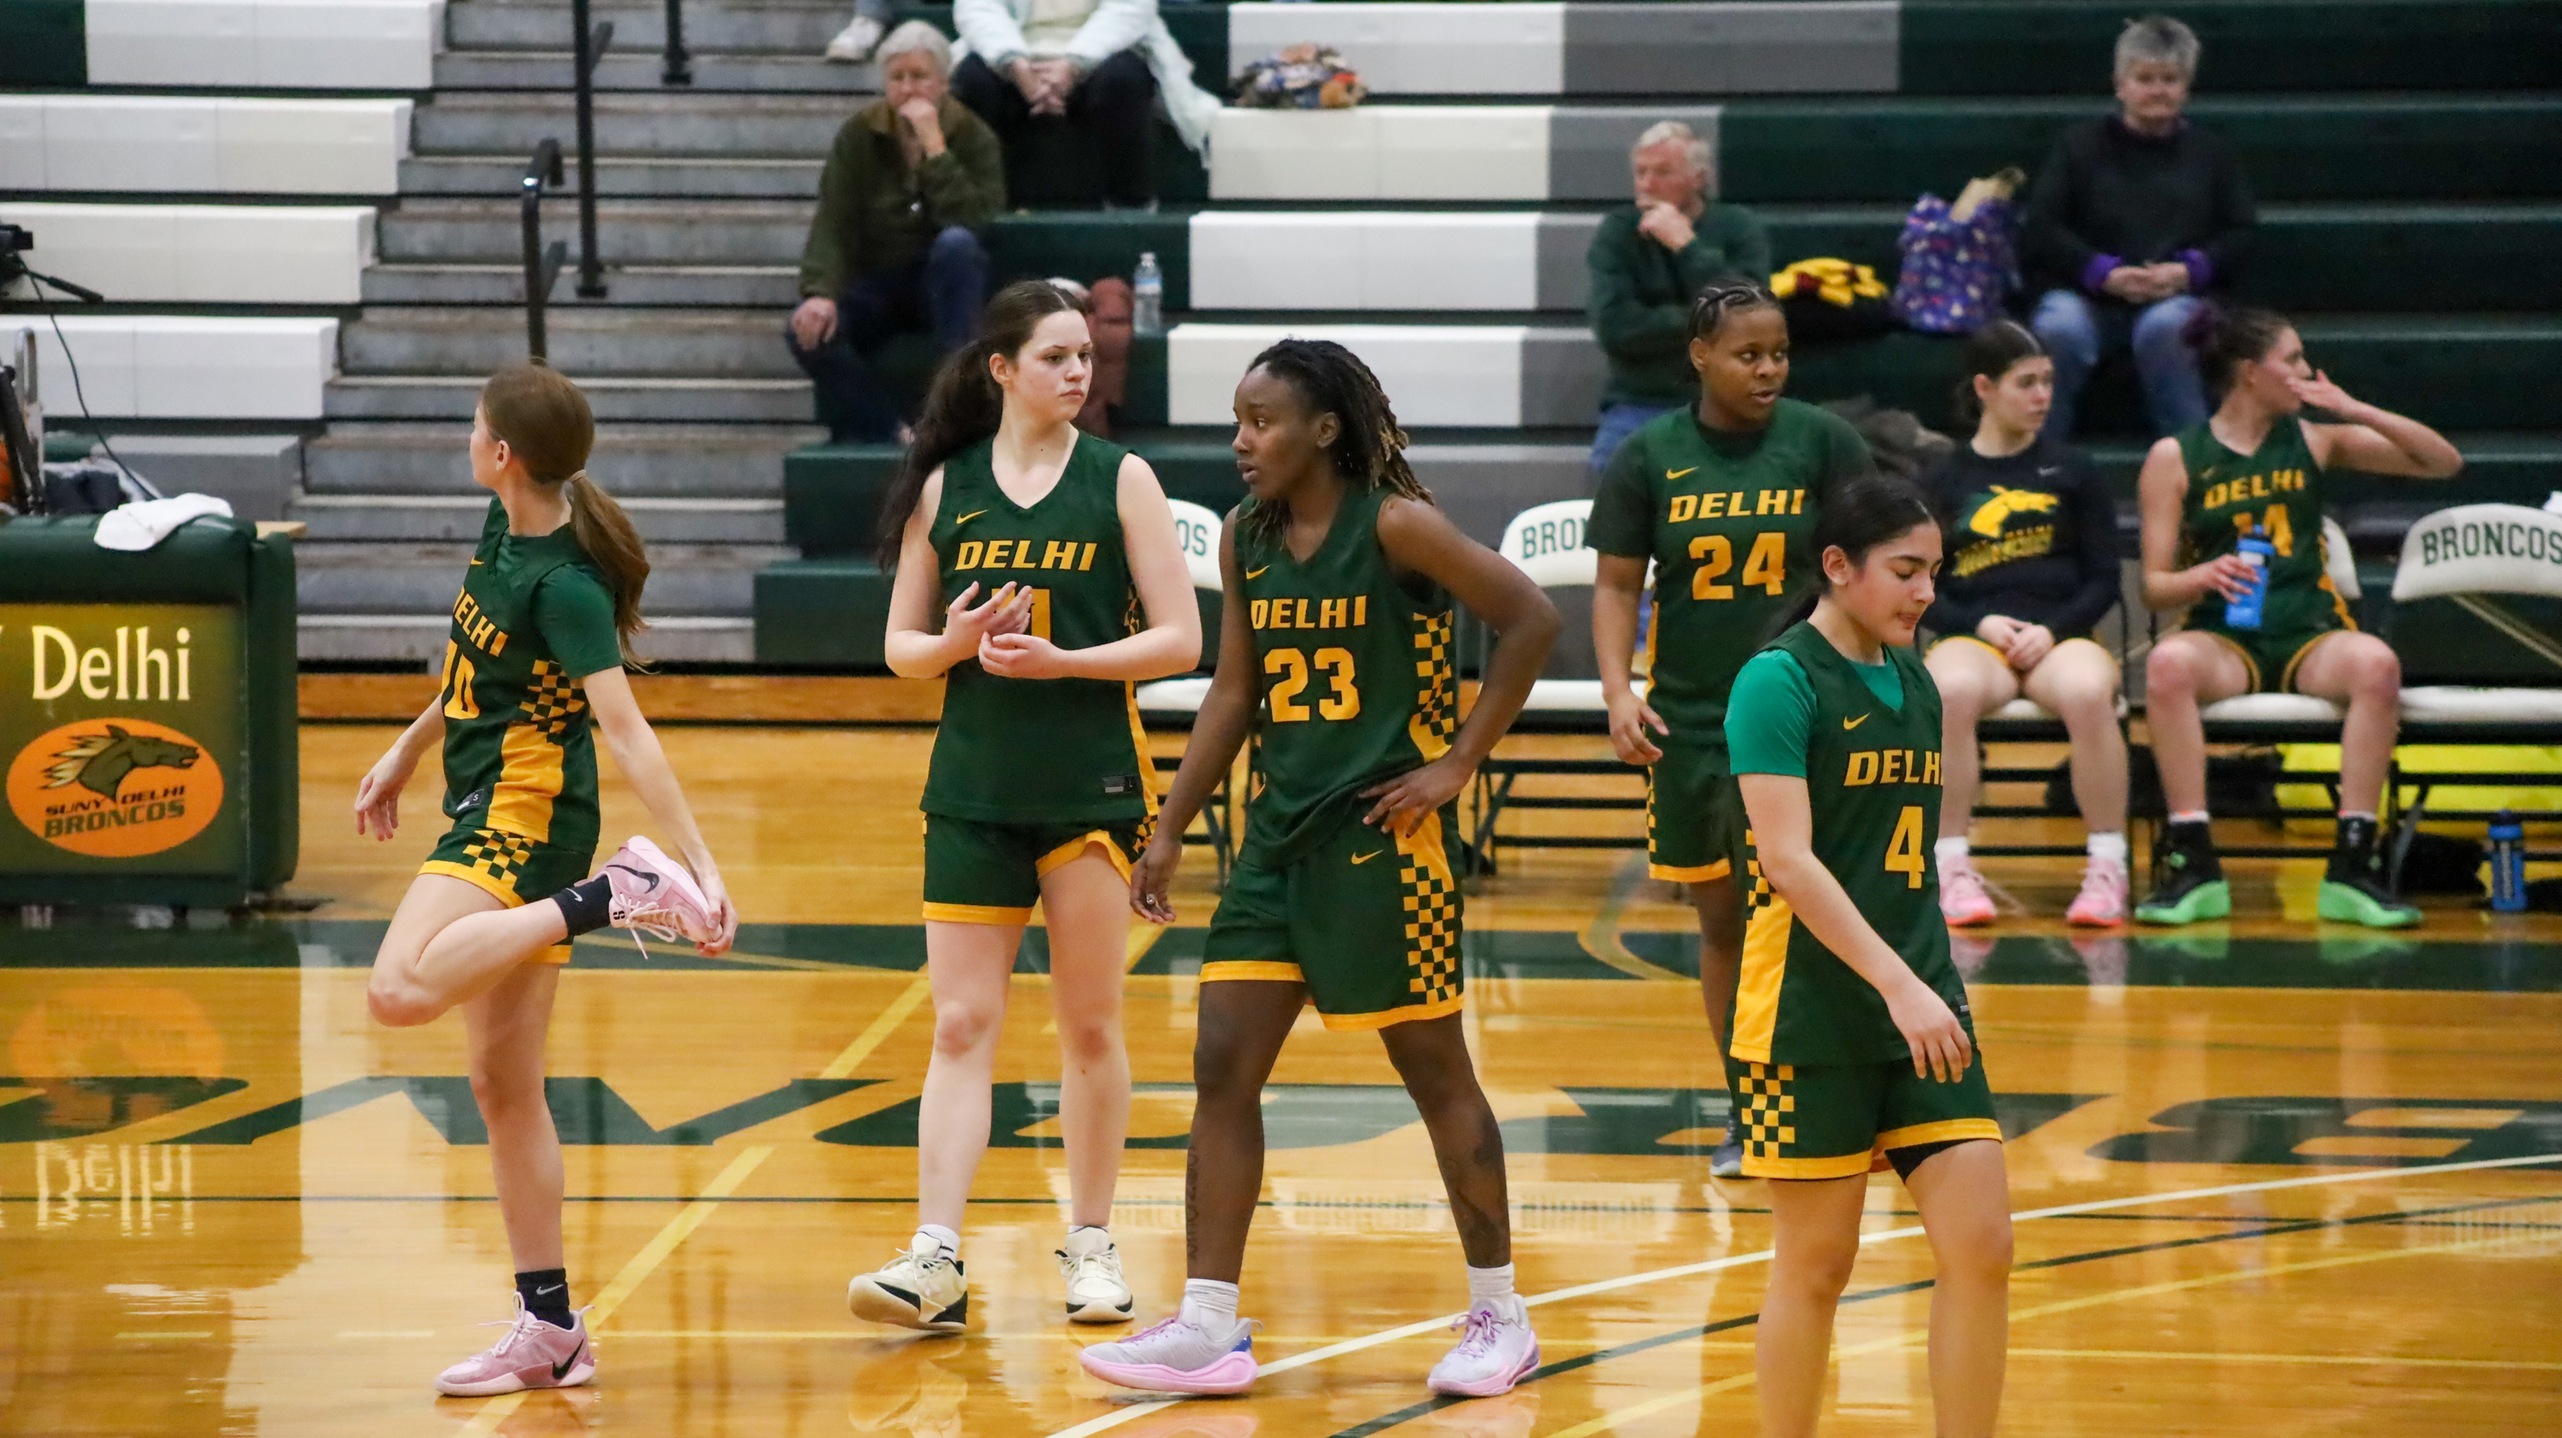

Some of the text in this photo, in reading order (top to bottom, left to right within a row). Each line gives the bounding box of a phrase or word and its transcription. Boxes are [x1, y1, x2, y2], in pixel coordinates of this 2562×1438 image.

[1668, 489, 1805, 523] DELHI
[2203, 468, 2305, 510] DELHI
[954, 540, 1098, 571] DELHI
[2421, 521, 2562, 566] BRONCOS
[1688, 531, 1786, 600] 24
[1251, 595, 1367, 630] DELHI
[32, 625, 191, 700] Delhi
[1264, 647, 1361, 723] 23
[1843, 749, 1944, 786] DELH
[45, 786, 185, 815] SUNY DELHI
[472, 793, 479, 802] S
[44, 799, 185, 838] BRONCOS
[1885, 805, 1926, 889] 4
